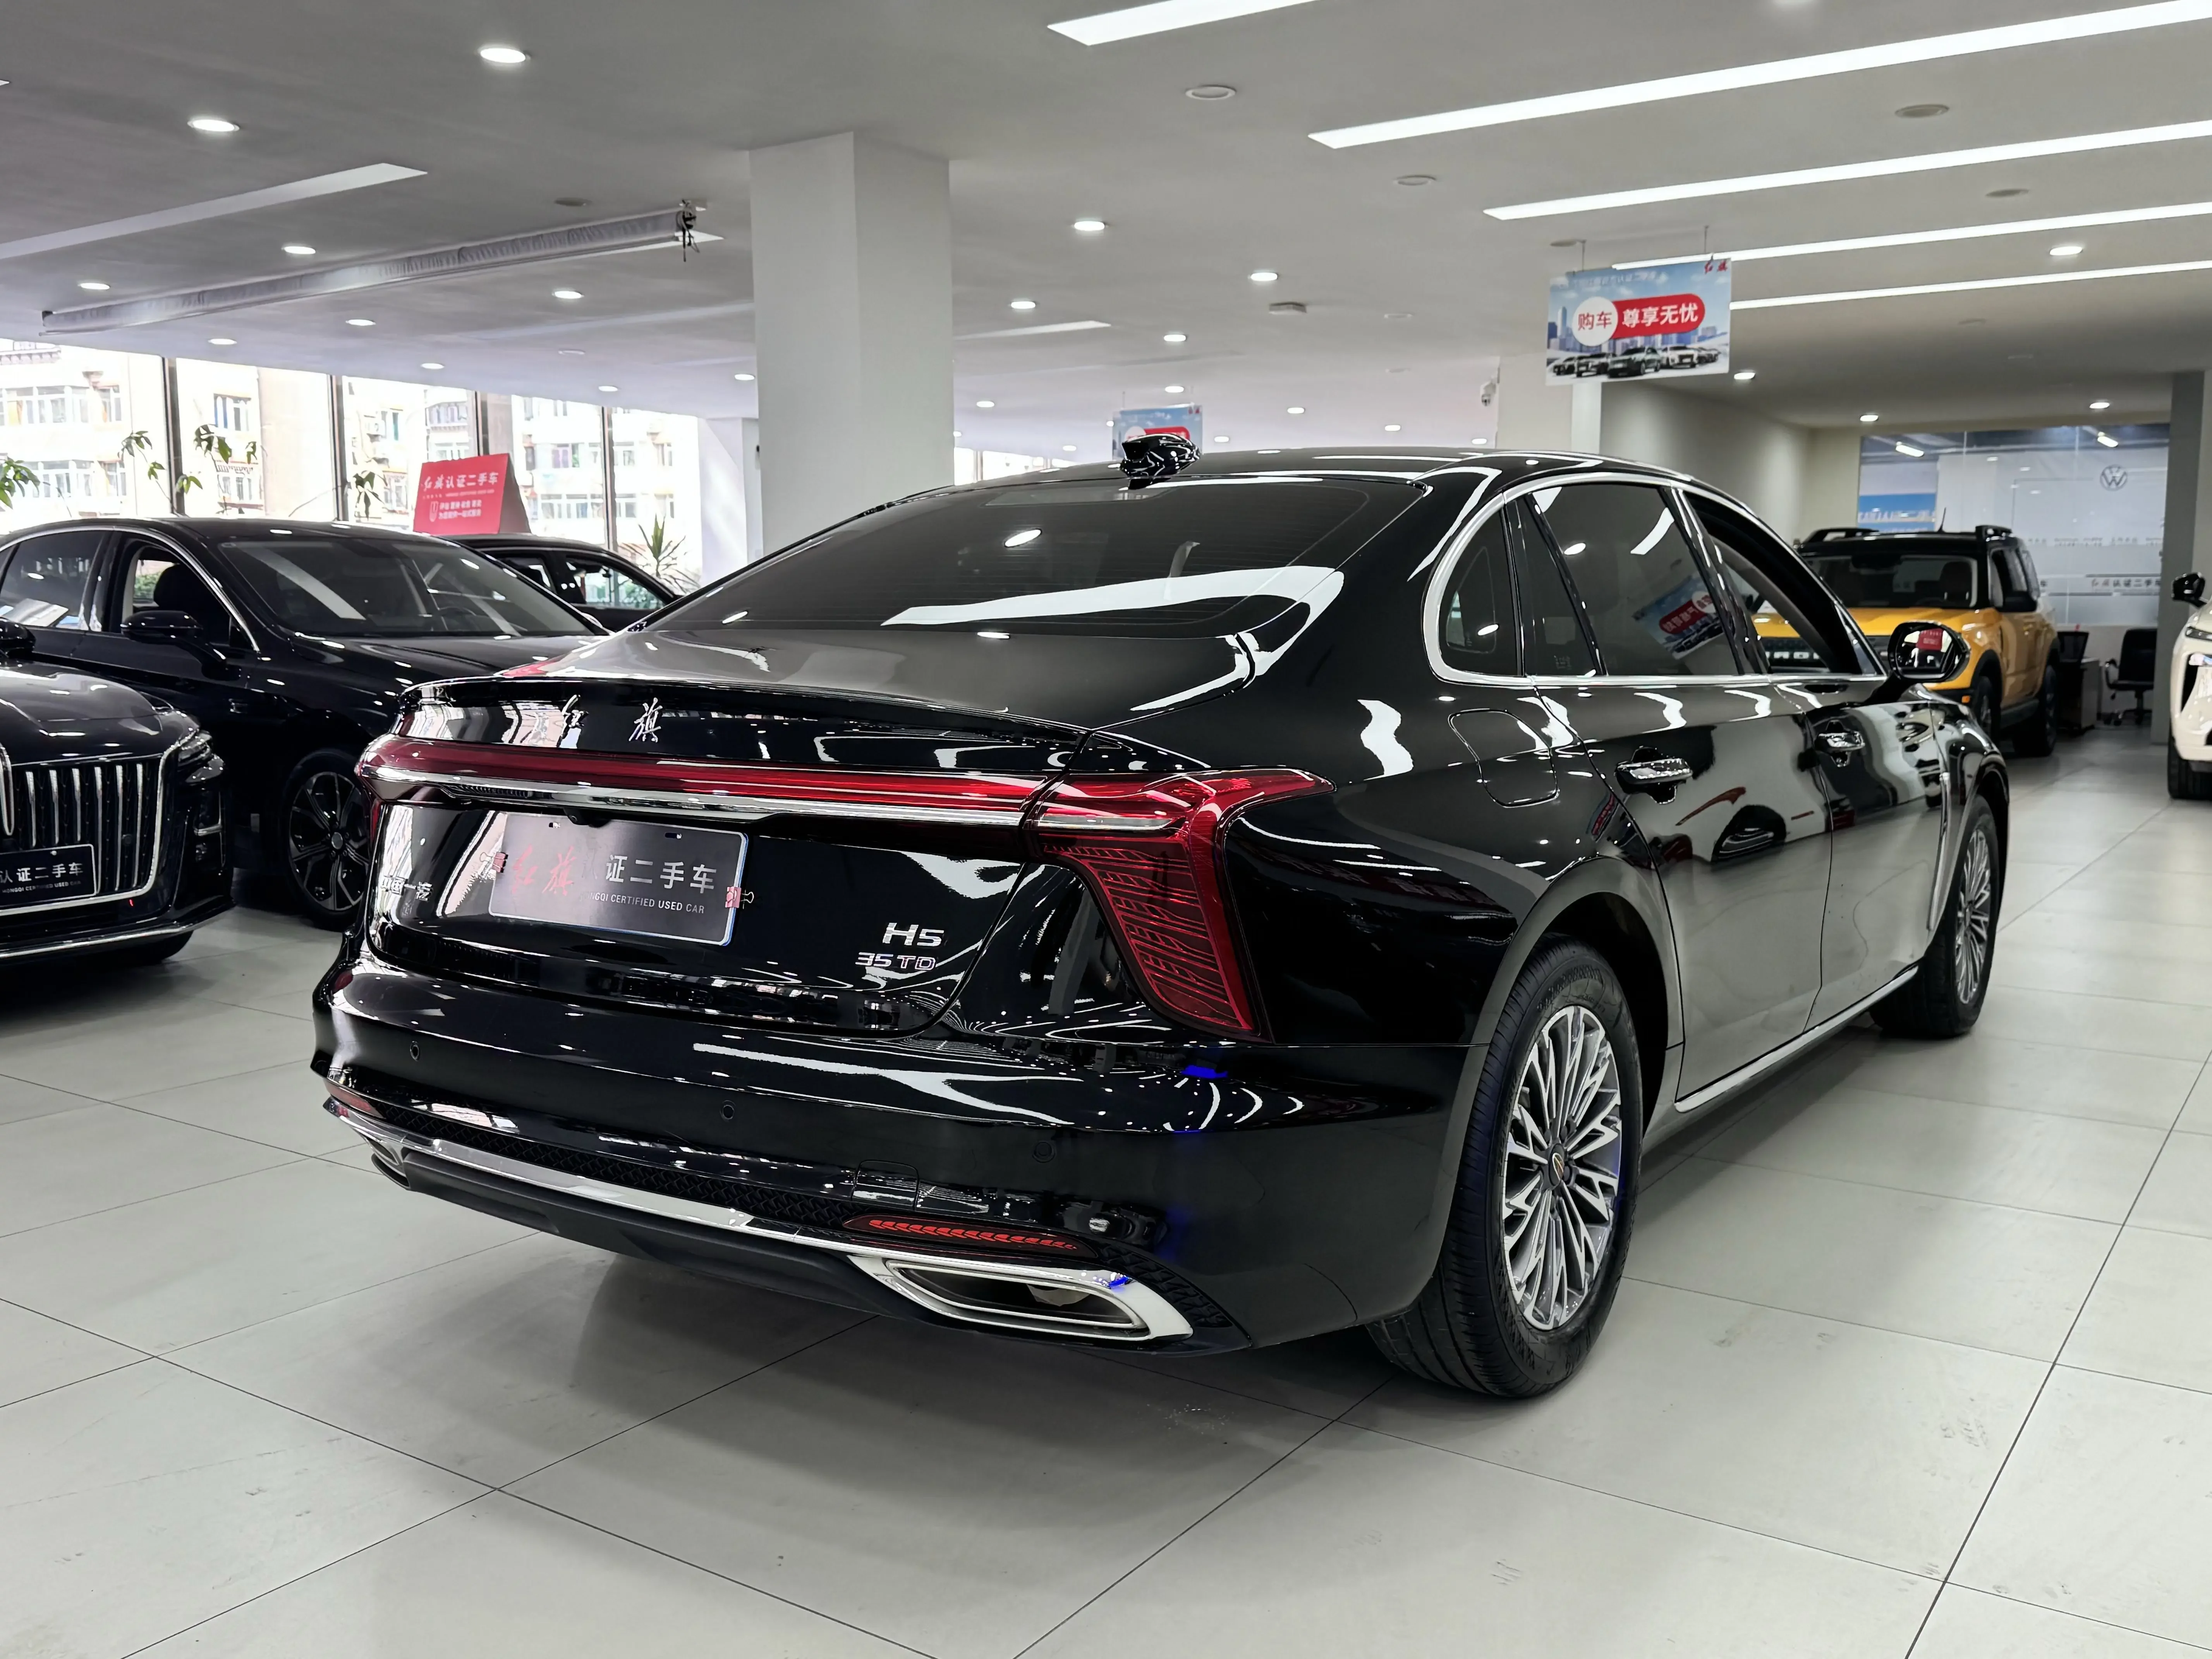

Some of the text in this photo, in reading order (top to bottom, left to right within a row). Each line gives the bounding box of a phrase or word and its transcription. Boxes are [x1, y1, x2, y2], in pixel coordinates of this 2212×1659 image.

[1578, 302, 1698, 331] 购车 尊享无忧
[0, 862, 83, 883] 认证二手车
[611, 894, 655, 907] CERTIFIED
[658, 900, 683, 911] USED
[686, 903, 705, 914] CAR
[882, 922, 944, 947] H5
